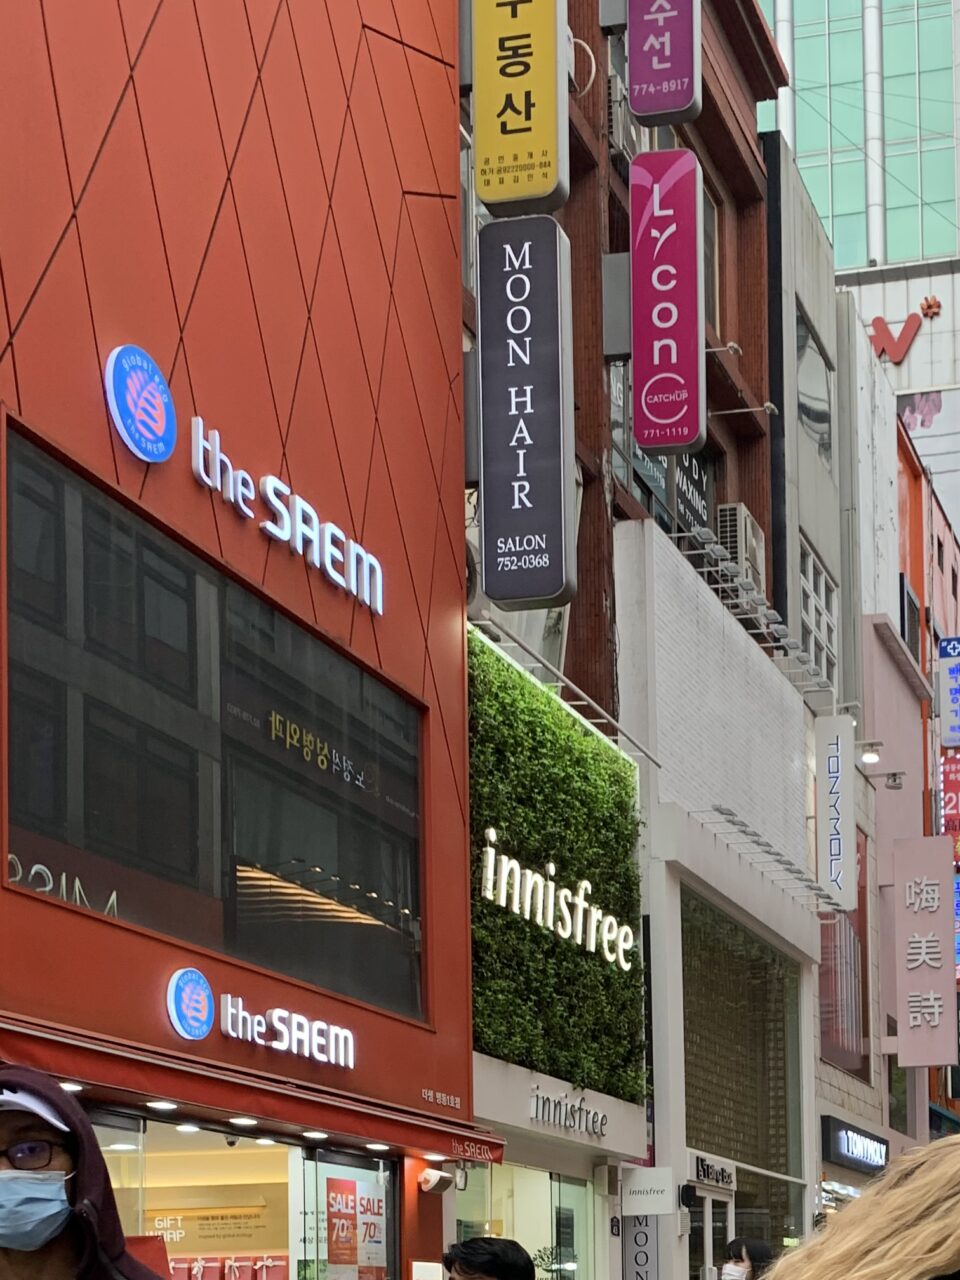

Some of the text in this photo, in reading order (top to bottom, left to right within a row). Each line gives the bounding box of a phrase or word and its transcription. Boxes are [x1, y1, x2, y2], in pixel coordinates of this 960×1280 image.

[643, 0, 678, 70] 수선
[632, 78, 689, 97] 774-8917
[503, 241, 535, 510] MOON HAIR
[647, 389, 688, 404] CATCHUP
[643, 427, 688, 438] 771-1119
[192, 416, 383, 616] the SAEM
[497, 535, 547, 553] SALON
[497, 552, 550, 571] 752-0368
[828, 735, 843, 891] TONYMOLY
[481, 827, 634, 971] innisfree
[905, 876, 943, 1029] 嗨美詩
[220, 993, 355, 1070] the SAEM
[531, 1084, 608, 1137] innisfree
[452, 1138, 493, 1160] the SAEM
[628, 1186, 666, 1197] innisfree
[329, 1192, 355, 1214] SALE
[359, 1196, 383, 1216] SALE
[154, 1215, 184, 1229] GIFT
